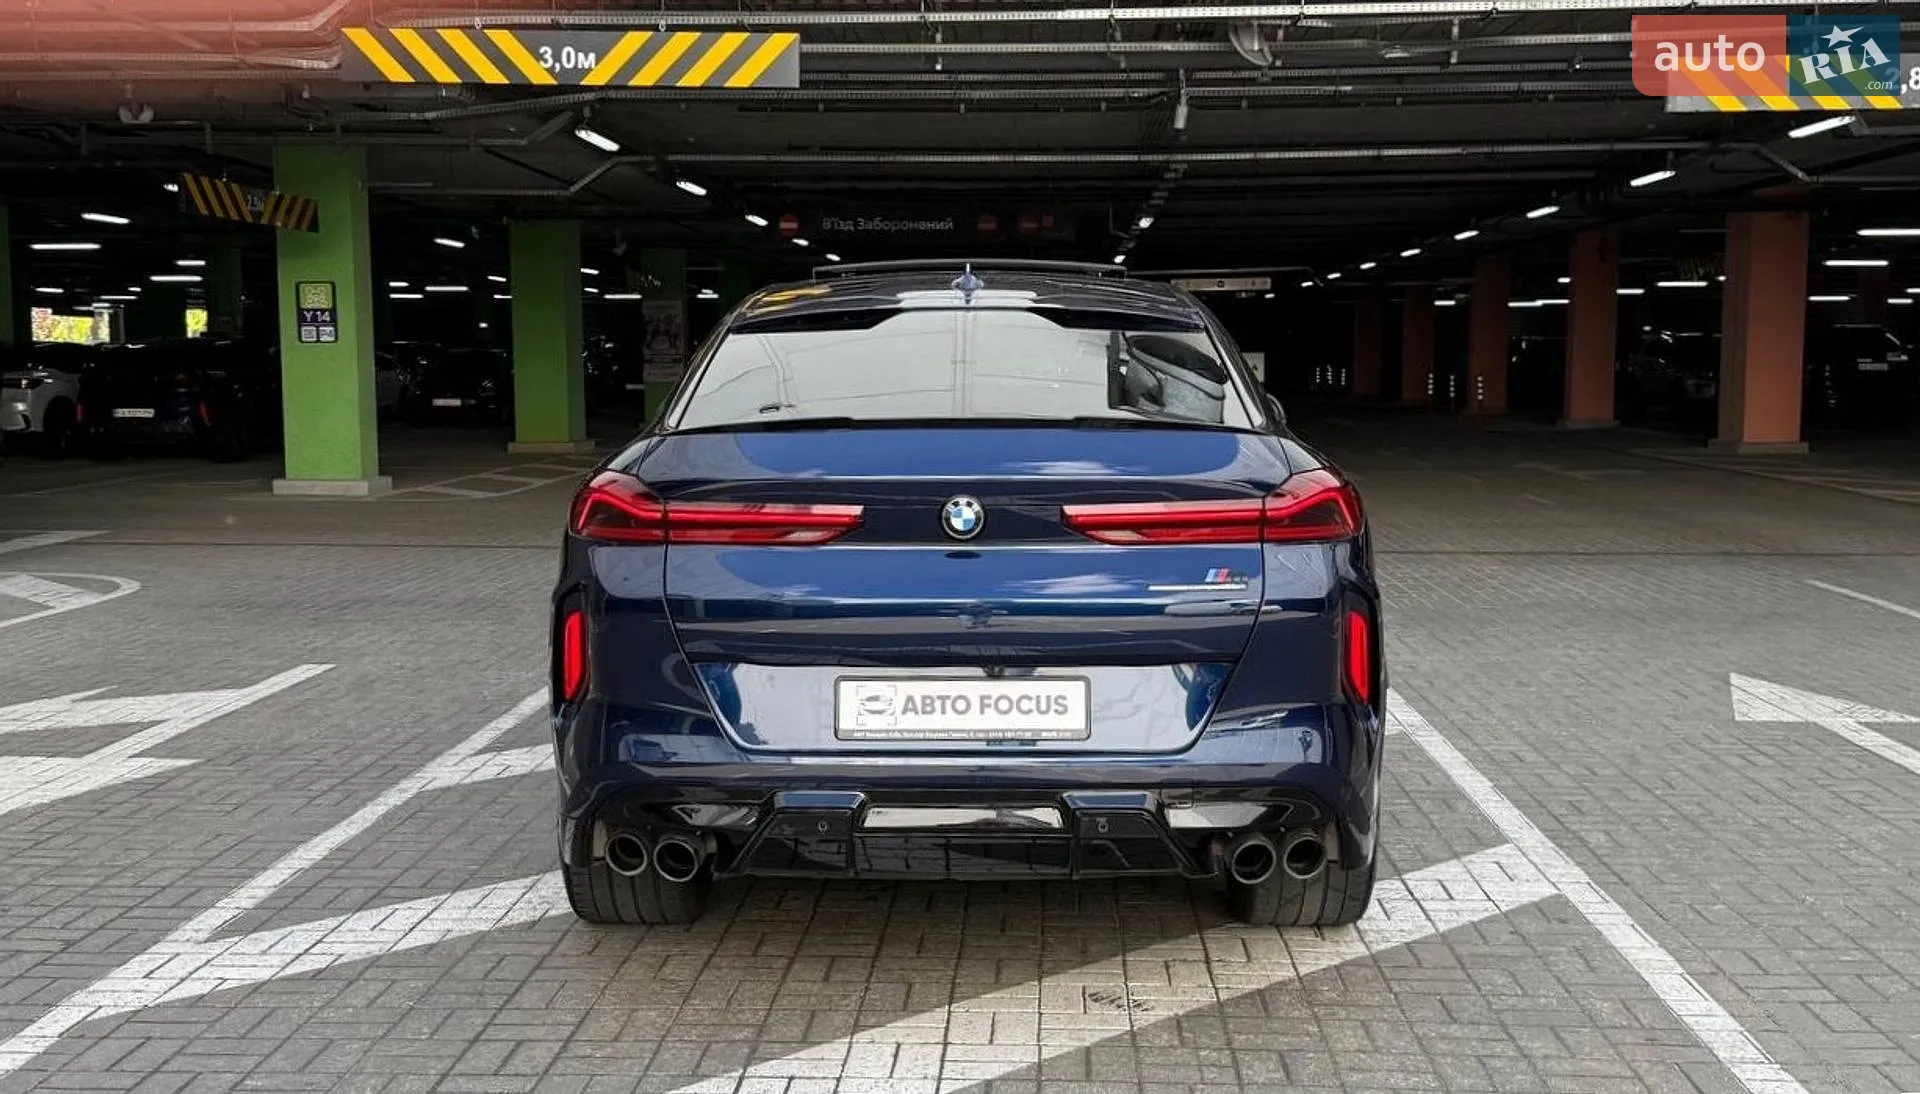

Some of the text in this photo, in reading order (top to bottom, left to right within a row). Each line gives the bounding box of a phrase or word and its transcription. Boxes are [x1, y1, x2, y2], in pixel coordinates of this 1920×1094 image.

[539, 46, 596, 73] 3,0м
[856, 215, 954, 232] Заборонений
[315, 310, 331, 322] 14
[900, 694, 1069, 716] АВТО FOCUS
